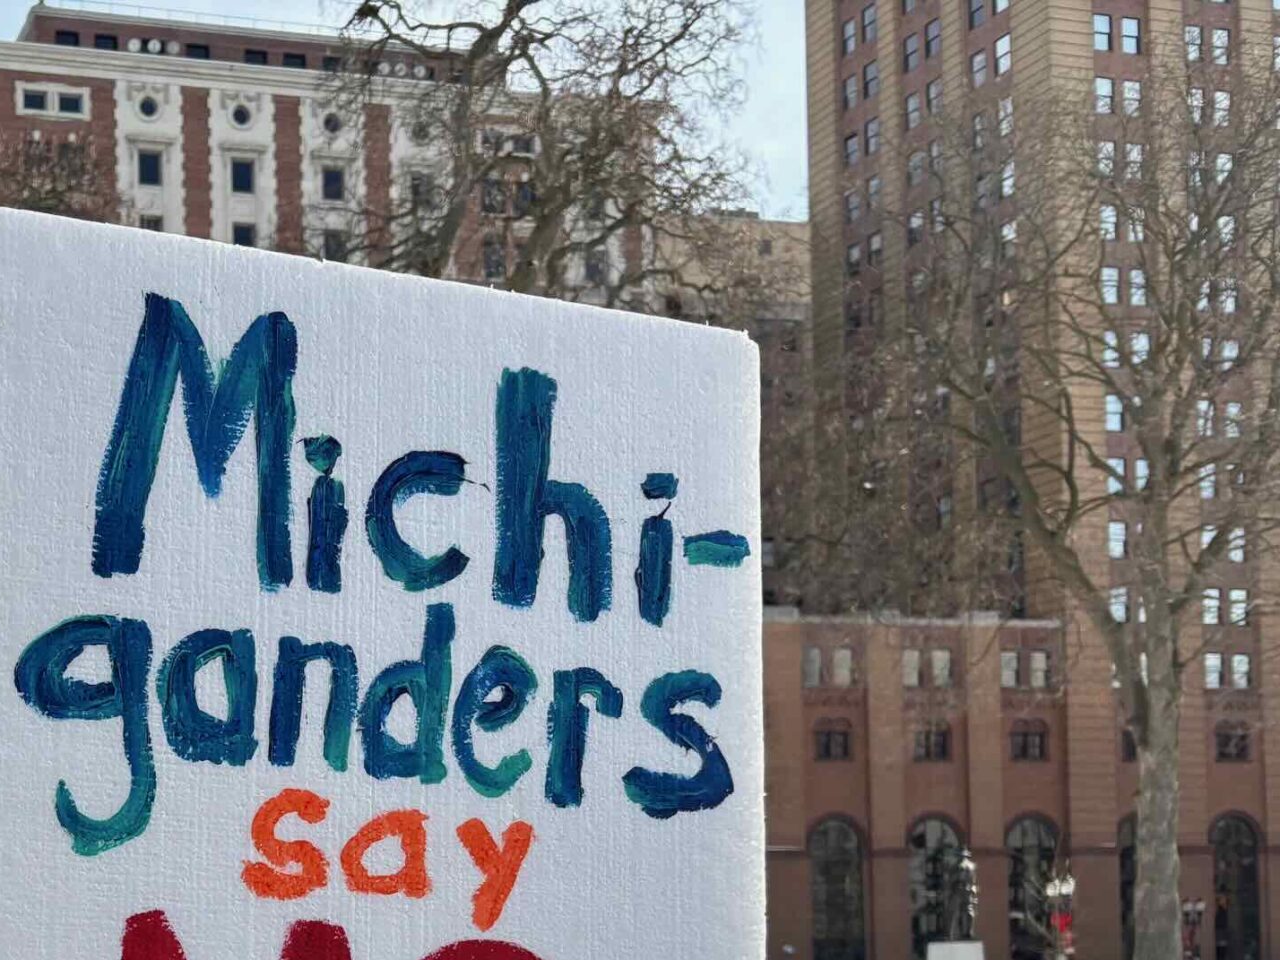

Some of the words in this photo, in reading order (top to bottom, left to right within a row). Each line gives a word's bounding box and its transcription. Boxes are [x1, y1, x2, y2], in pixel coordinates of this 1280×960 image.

[91, 292, 751, 627] Michi-
[13, 602, 735, 856] ganders
[241, 788, 536, 932] say
